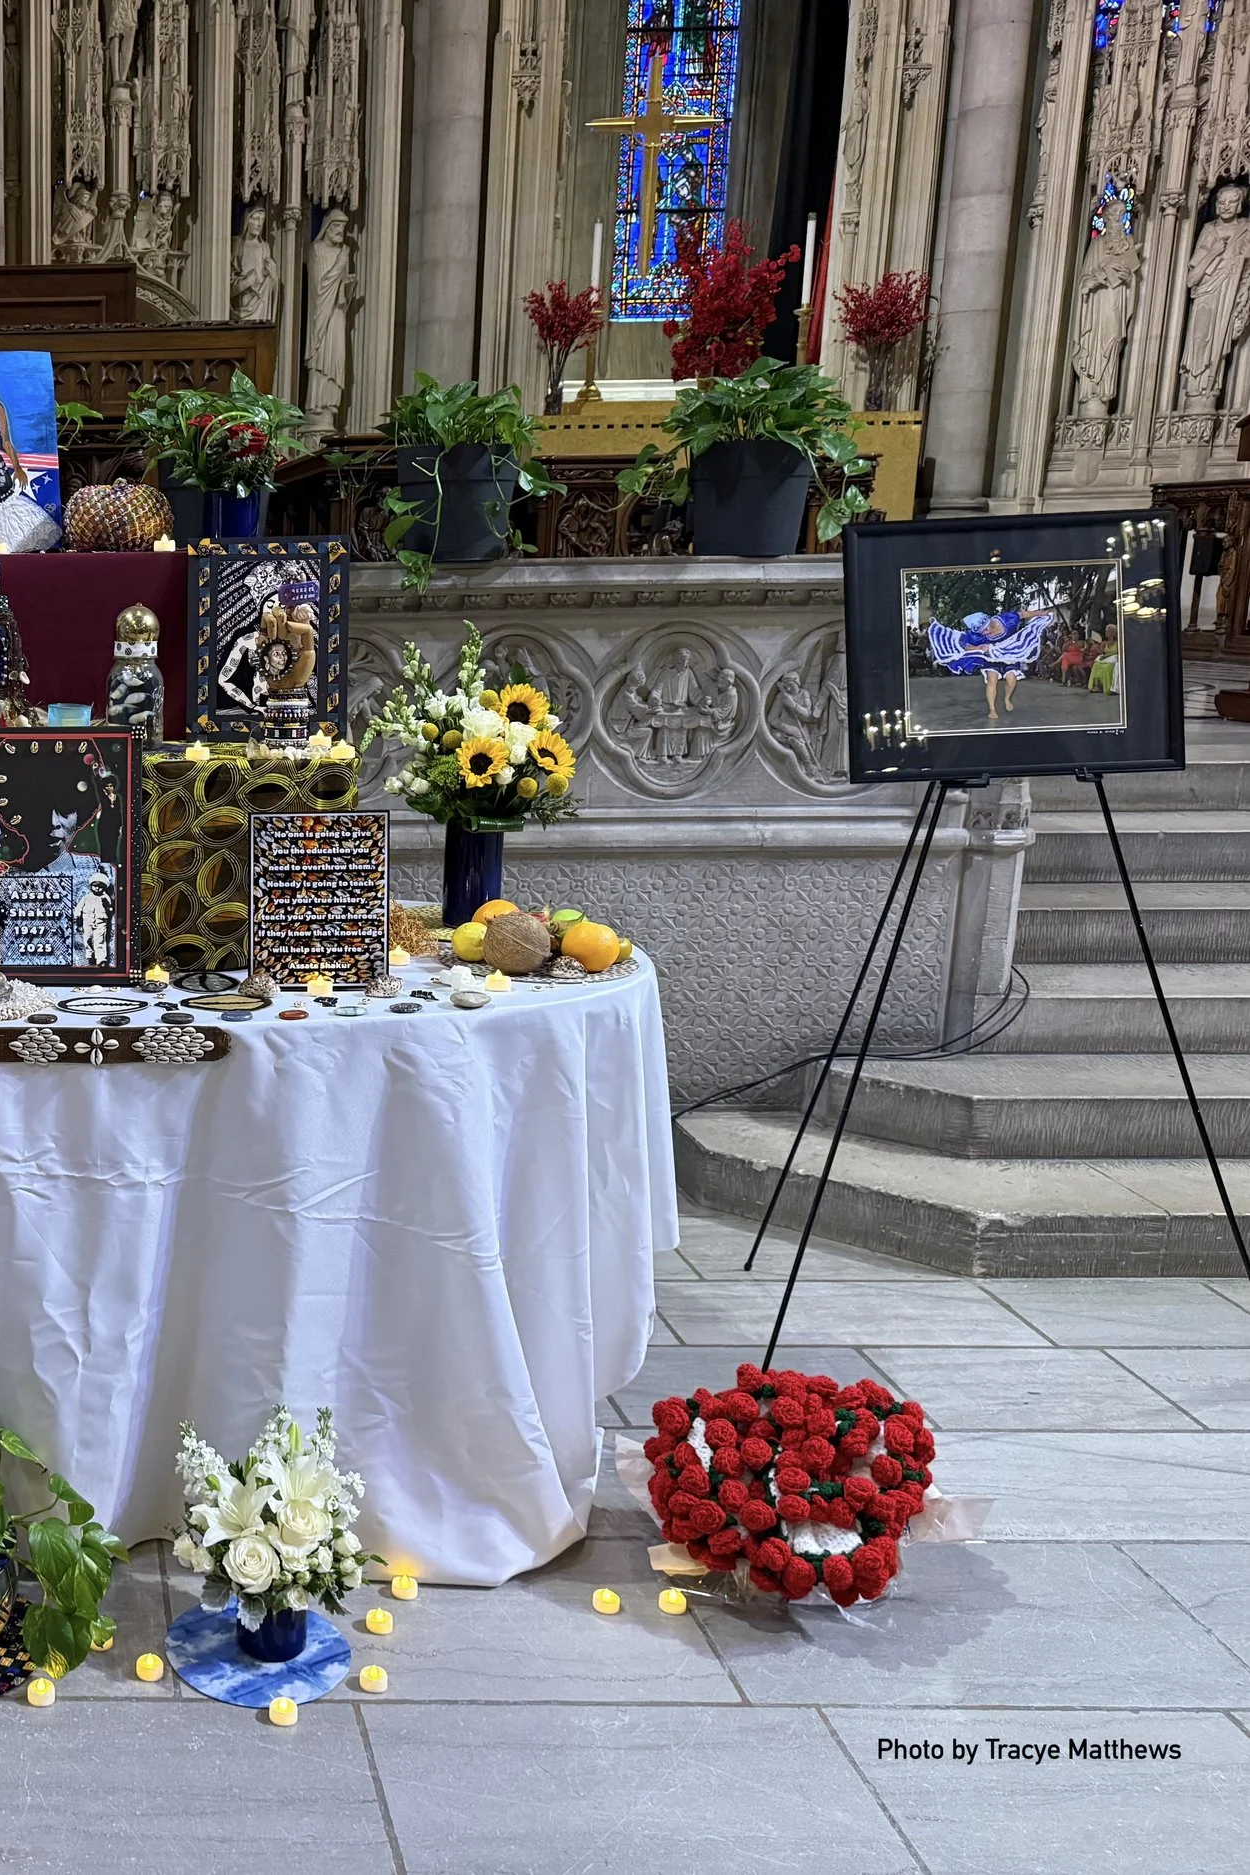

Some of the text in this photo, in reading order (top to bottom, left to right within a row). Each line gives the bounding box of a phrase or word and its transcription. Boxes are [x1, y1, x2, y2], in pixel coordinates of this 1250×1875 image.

[315, 831, 340, 839] going
[266, 880, 302, 889] Nobody
[312, 880, 338, 889] going
[350, 879, 374, 887] teach
[10, 890, 60, 900] Assata
[9, 908, 61, 917] Shakur
[261, 913, 286, 921] teach
[305, 914, 327, 922] your
[14, 926, 45, 935] 1947
[266, 929, 286, 938] they
[287, 929, 312, 937] know
[312, 929, 332, 937] that
[334, 929, 383, 937] knowledge
[18, 943, 52, 953] 2025
[290, 946, 310, 954] help
[319, 961, 351, 969] Shakur
